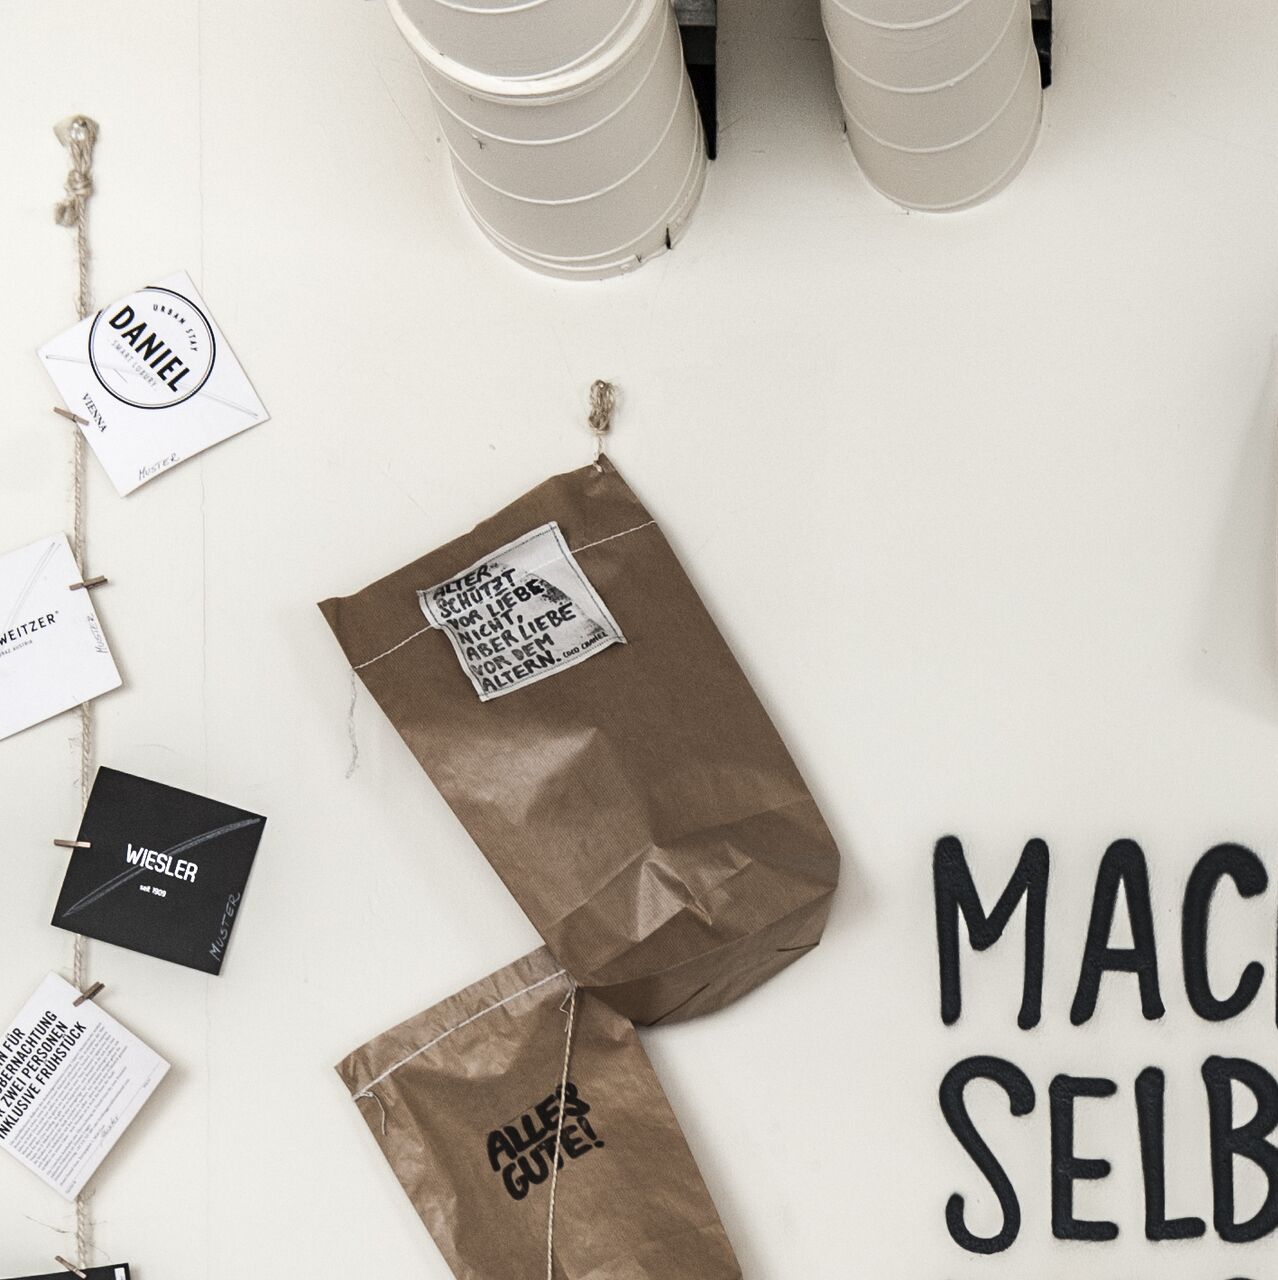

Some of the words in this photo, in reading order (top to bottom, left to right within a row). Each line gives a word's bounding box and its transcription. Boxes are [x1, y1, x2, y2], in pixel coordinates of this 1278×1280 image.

[109, 305, 190, 392] DANIEL
[153, 303, 186, 324] URBAN
[185, 328, 199, 352] STAY
[82, 392, 107, 433] VIENNA
[138, 453, 180, 481] MUSTER
[432, 564, 492, 600] ALTER
[446, 611, 483, 631] VOR
[486, 578, 545, 618] LIEBE
[466, 630, 519, 661] ABER
[517, 602, 576, 641] LIEBE
[470, 653, 512, 676] VOR
[511, 633, 555, 661] DEM
[125, 843, 199, 883] WIESLER
[152, 885, 167, 898] 1909
[209, 892, 241, 961] MUSTER
[1, 1077, 27, 1108] ZWEI
[21, 1020, 68, 1079] PERSONEN
[3, 1027, 26, 1053] FÜR
[487, 1081, 591, 1172] ALLES
[502, 1115, 605, 1201] GUTE!
